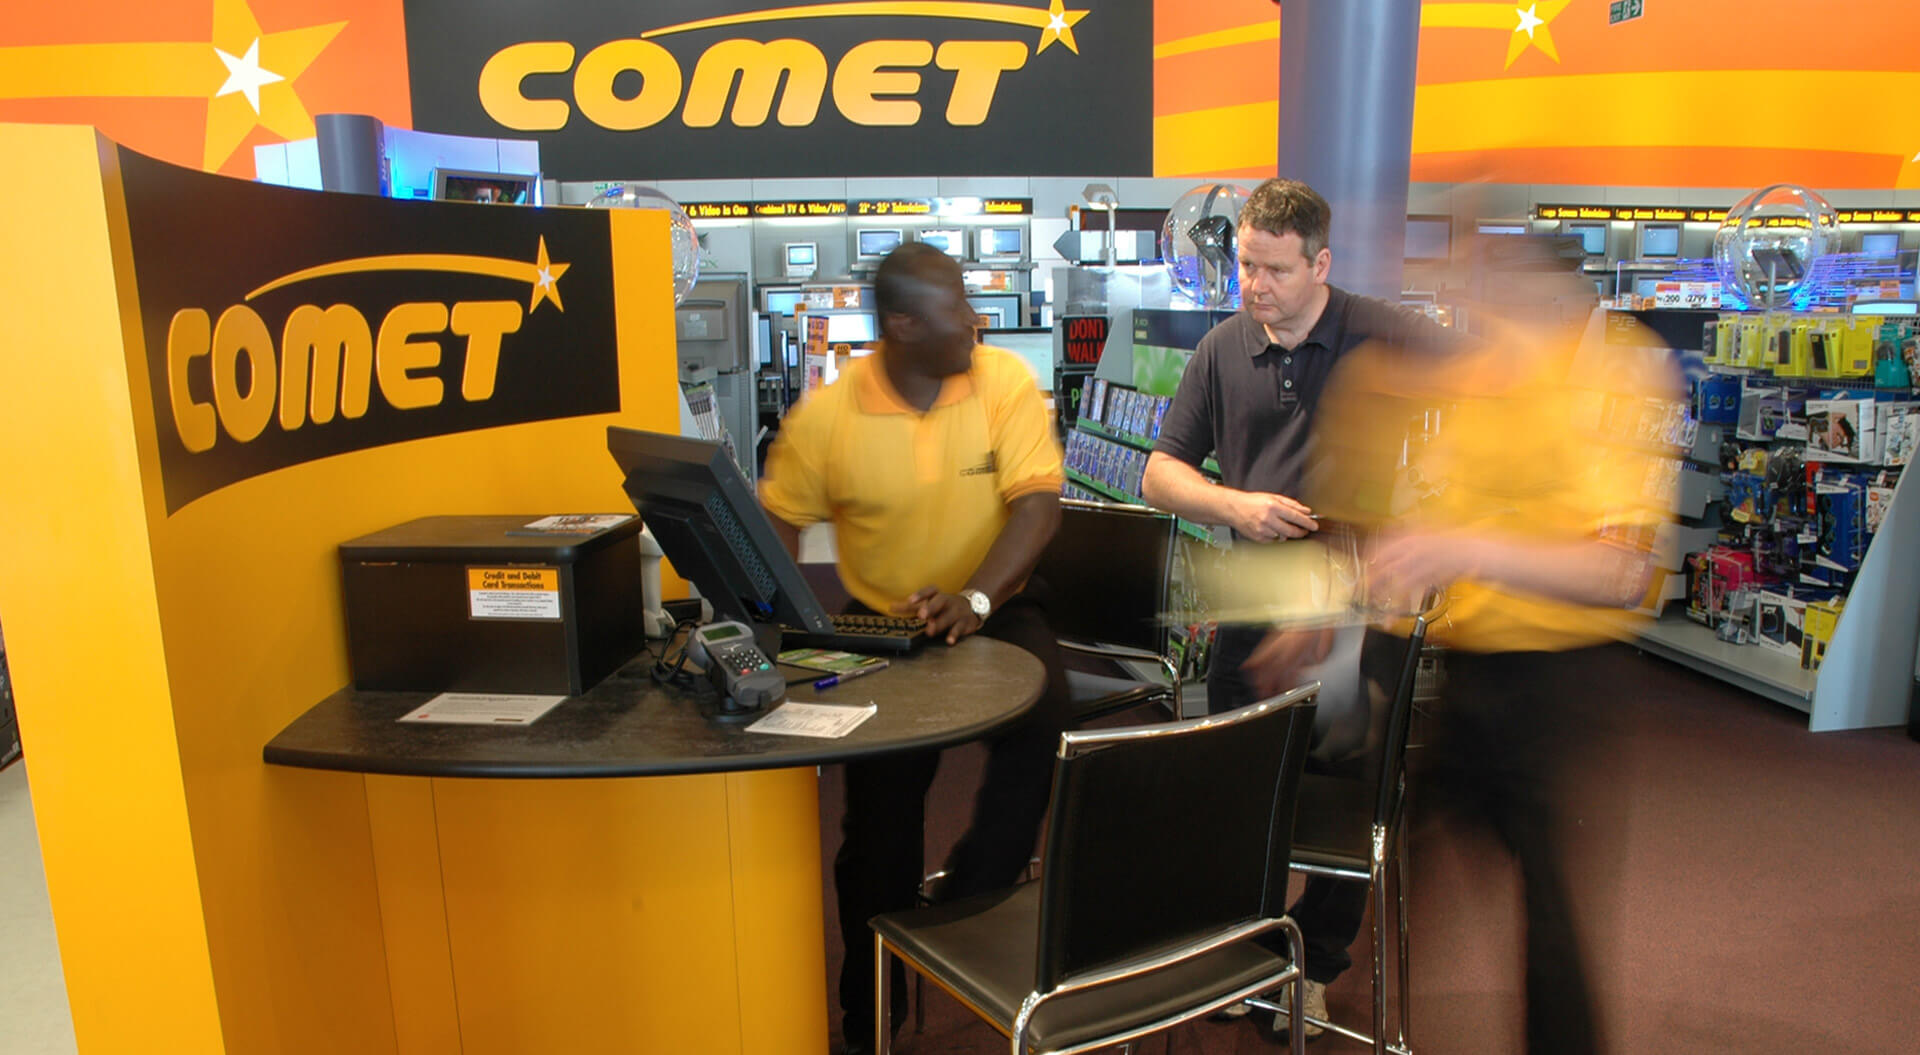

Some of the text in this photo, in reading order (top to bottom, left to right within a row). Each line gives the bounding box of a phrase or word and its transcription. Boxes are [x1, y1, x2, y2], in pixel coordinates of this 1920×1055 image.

[478, 38, 1028, 131] COMET
[689, 204, 697, 216] &
[699, 203, 721, 216] Video
[732, 203, 749, 216] One
[787, 202, 797, 214] TV
[799, 203, 806, 214] &
[891, 202, 930, 213] Televisions
[984, 201, 1023, 212] Televisions
[1558, 207, 1578, 218] Screen
[1633, 208, 1654, 219] Screen
[168, 300, 523, 454] COMET
[484, 571, 541, 580] Credit and Debit
[482, 580, 544, 589] Card Transactions
